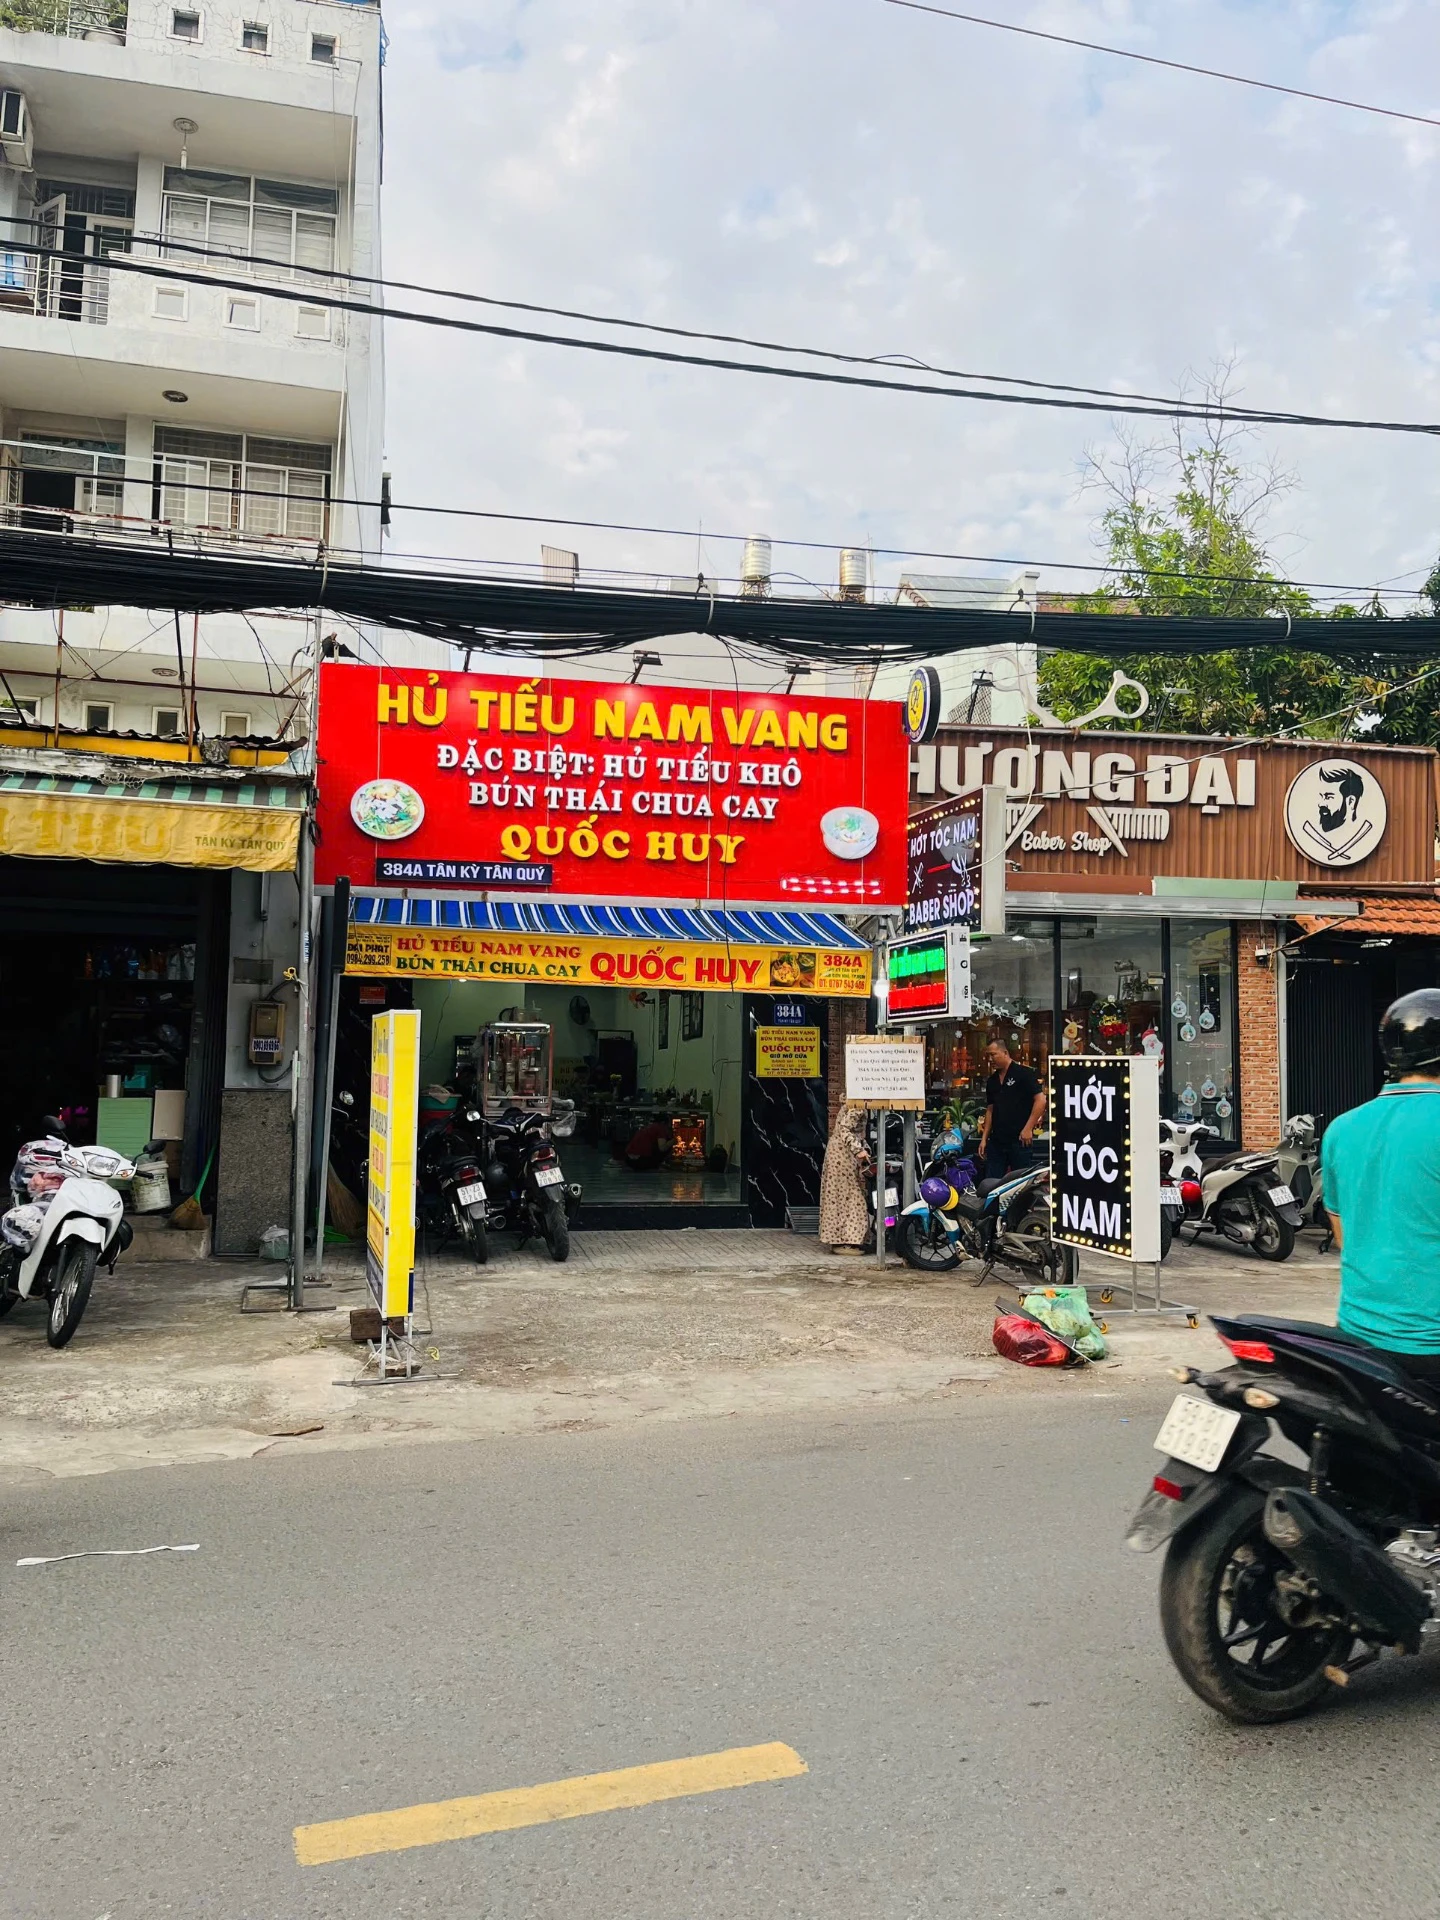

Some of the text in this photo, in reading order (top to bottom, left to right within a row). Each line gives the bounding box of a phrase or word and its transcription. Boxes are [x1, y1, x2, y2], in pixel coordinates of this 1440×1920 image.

[378, 673, 848, 750] HỦ TIẾU NAM VANG
[437, 739, 802, 787] ĐẶC BIỆT: HỦ TIẾU KHÔ
[468, 775, 779, 820] BÚN THÁI CHUA CAY
[1143, 754, 1256, 814] ĐẠI
[195, 834, 217, 846] TÂN
[221, 836, 235, 848] KỲ
[240, 838, 260, 850] TÂN
[500, 814, 746, 863] QUỐC HUY
[910, 816, 976, 858] HỚT TÓC NAM
[1021, 830, 1112, 856] Baber Shop
[383, 862, 545, 881] 384A TÂN KỲ TÂN QUÝ
[909, 888, 975, 925] BABER SHOP
[396, 933, 425, 951] HỦ
[430, 935, 475, 953] TIẾU
[480, 943, 523, 956] NAM
[529, 944, 581, 959] VANG
[396, 953, 582, 977] BÚN THÁI CHUA CAY
[590, 945, 763, 984] QUỐC HUY
[823, 954, 863, 968] 384A
[777, 1005, 802, 1018] 384A
[761, 1043, 791, 1053] QUỐC
[1064, 1074, 1116, 1122] HỚT
[1063, 1133, 1119, 1184] TÓC
[1062, 1193, 1121, 1240] NAM
